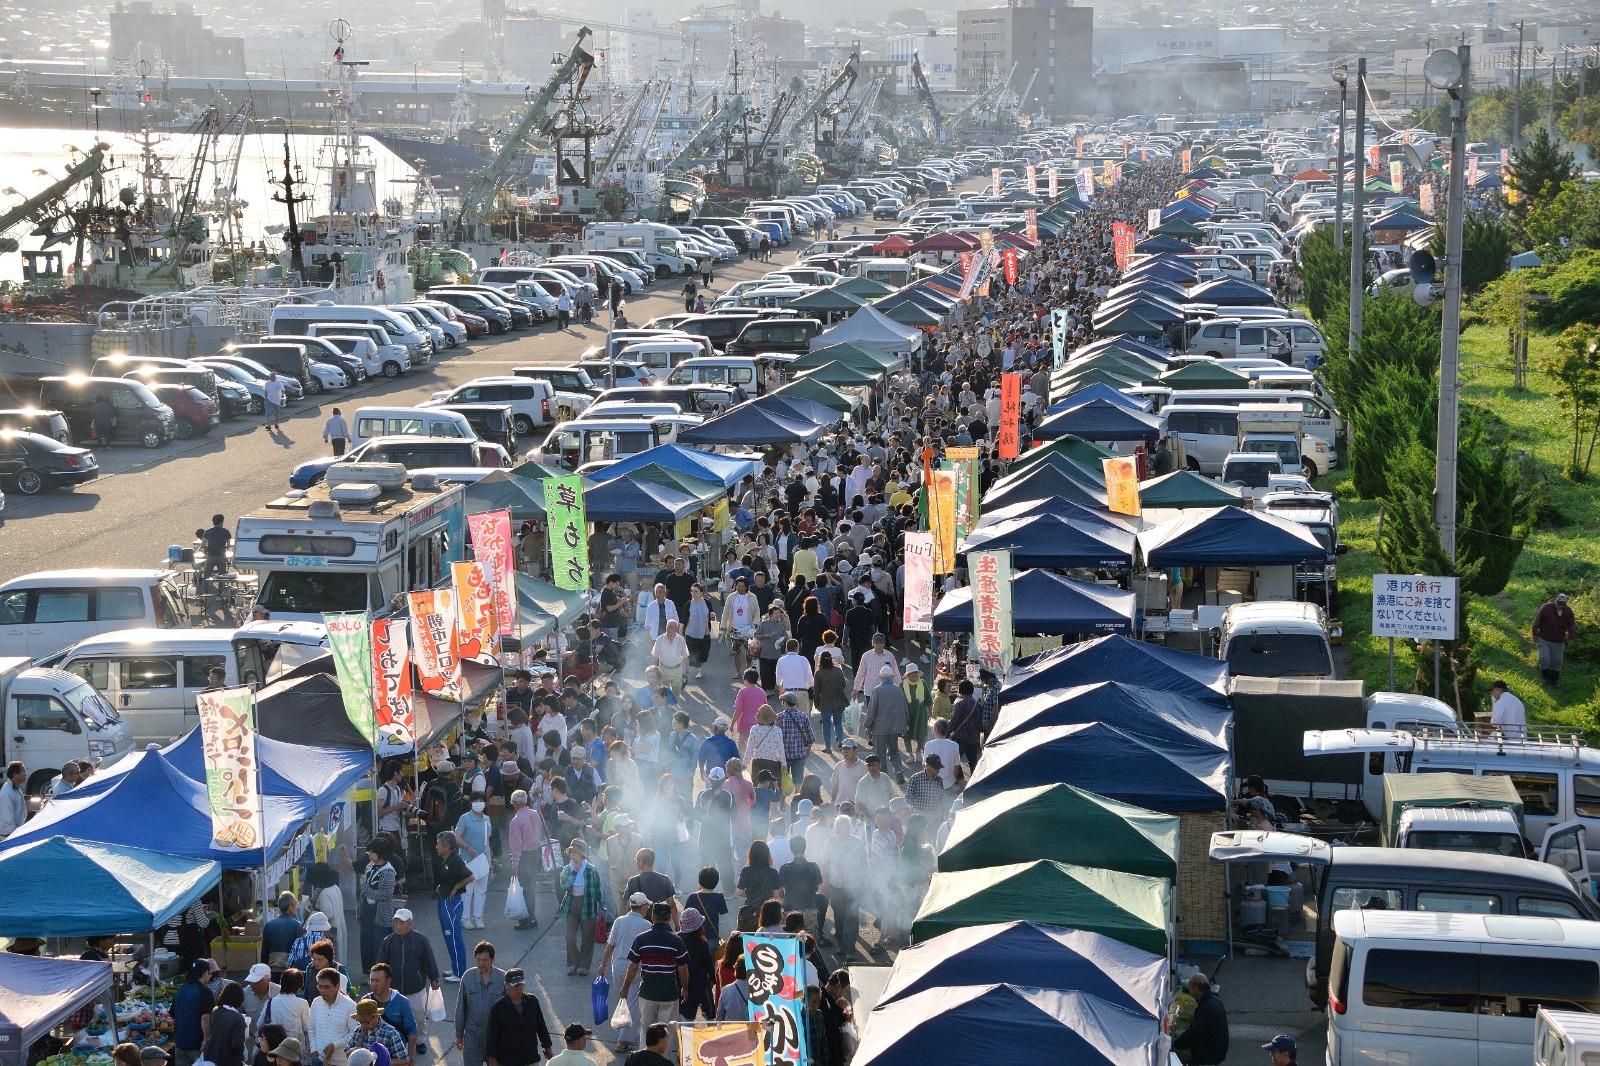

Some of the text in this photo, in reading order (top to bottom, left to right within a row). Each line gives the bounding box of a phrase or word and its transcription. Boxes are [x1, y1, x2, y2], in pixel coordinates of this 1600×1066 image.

[1386, 579, 1442, 593] 港内徐行
[1376, 594, 1452, 608] 漁港にごみを捨て
[1376, 609, 1446, 623] ないでください。
